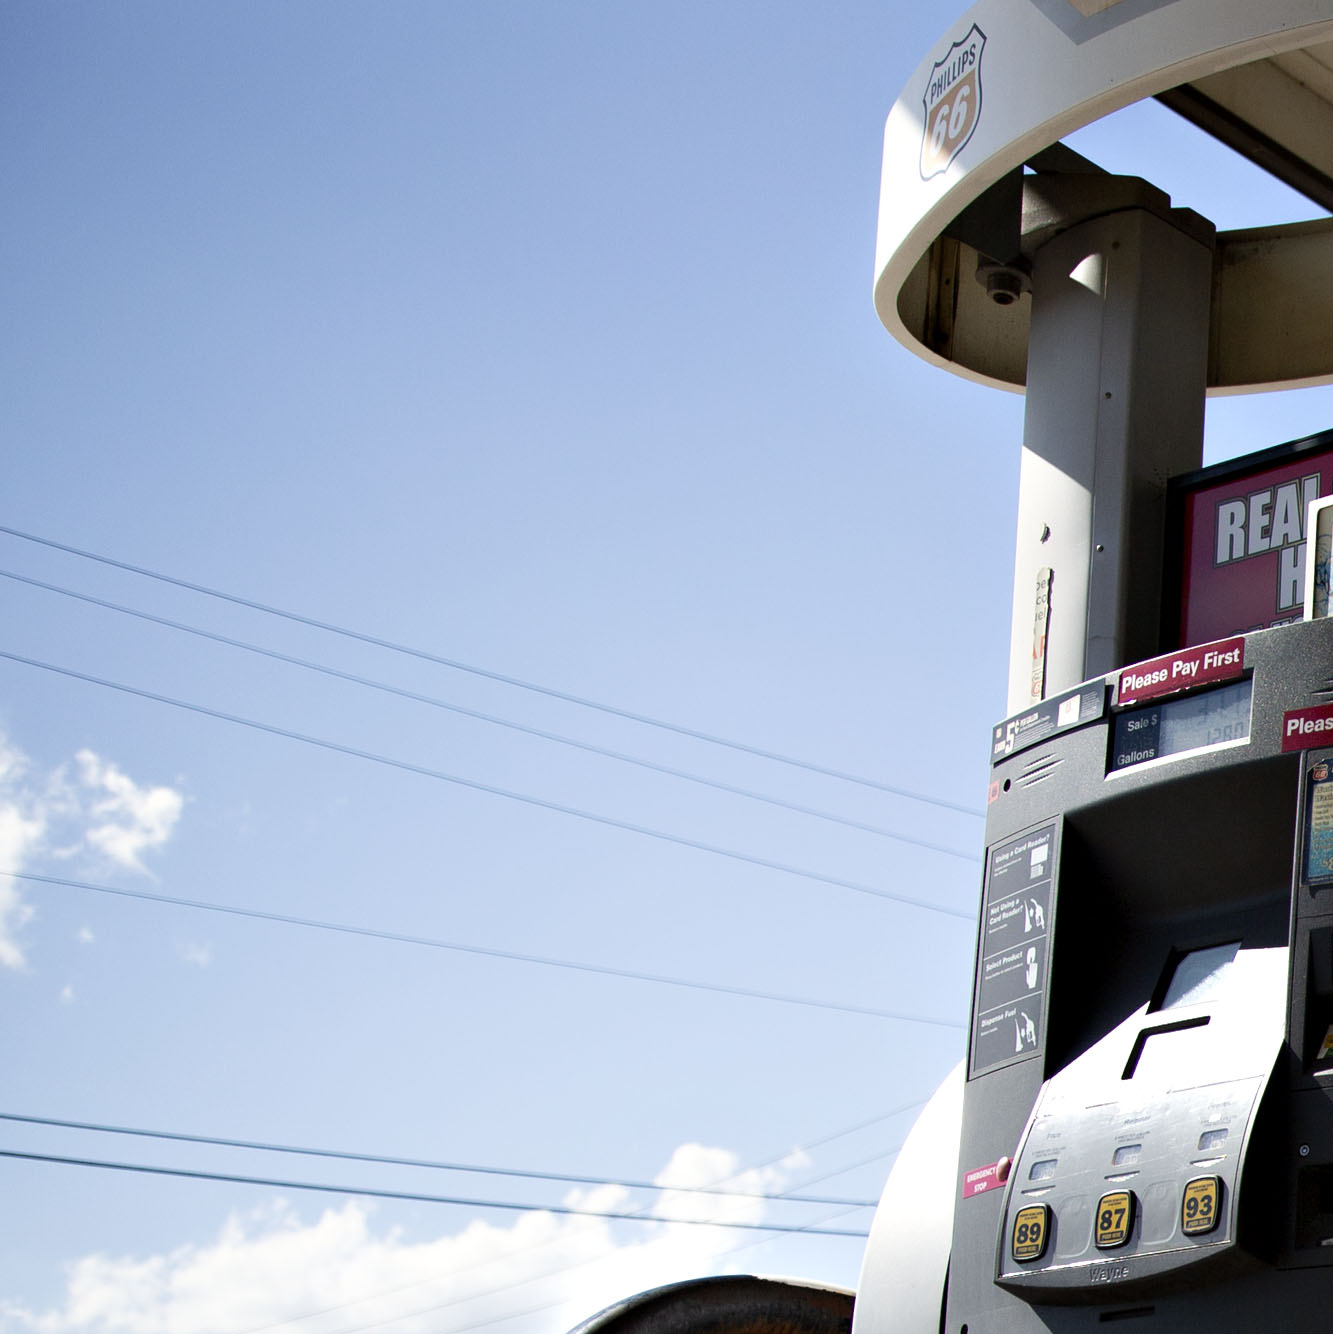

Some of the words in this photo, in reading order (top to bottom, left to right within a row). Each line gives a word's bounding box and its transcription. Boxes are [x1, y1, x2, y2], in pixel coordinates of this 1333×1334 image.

[930, 43, 977, 105] PHILLIPS
[929, 83, 970, 159] 66
[1121, 668, 1168, 694] Please
[1172, 660, 1200, 678] Pay
[1203, 648, 1240, 670] First
[1127, 717, 1149, 732] Sale
[1151, 714, 1158, 727] $
[1117, 748, 1155, 766] Gallons
[995, 851, 1009, 864] Using
[1014, 843, 1027, 855] Card
[1027, 834, 1050, 849] Reader?
[990, 905, 1000, 915] Not
[1000, 901, 1015, 912] Using
[989, 914, 1002, 925] Card
[985, 959, 1002, 972] Select
[1002, 951, 1023, 965] Product
[981, 1014, 1004, 1028] Dispense
[1004, 1008, 1017, 1019] Fuel
[966, 1166, 997, 1184] EMERGENCY
[974, 1181, 988, 1193] STOP
[1186, 1195, 1213, 1219] 93
[1100, 1208, 1126, 1232] 87
[1016, 1222, 1041, 1245] 89
[1089, 1266, 1129, 1283] Wayne
